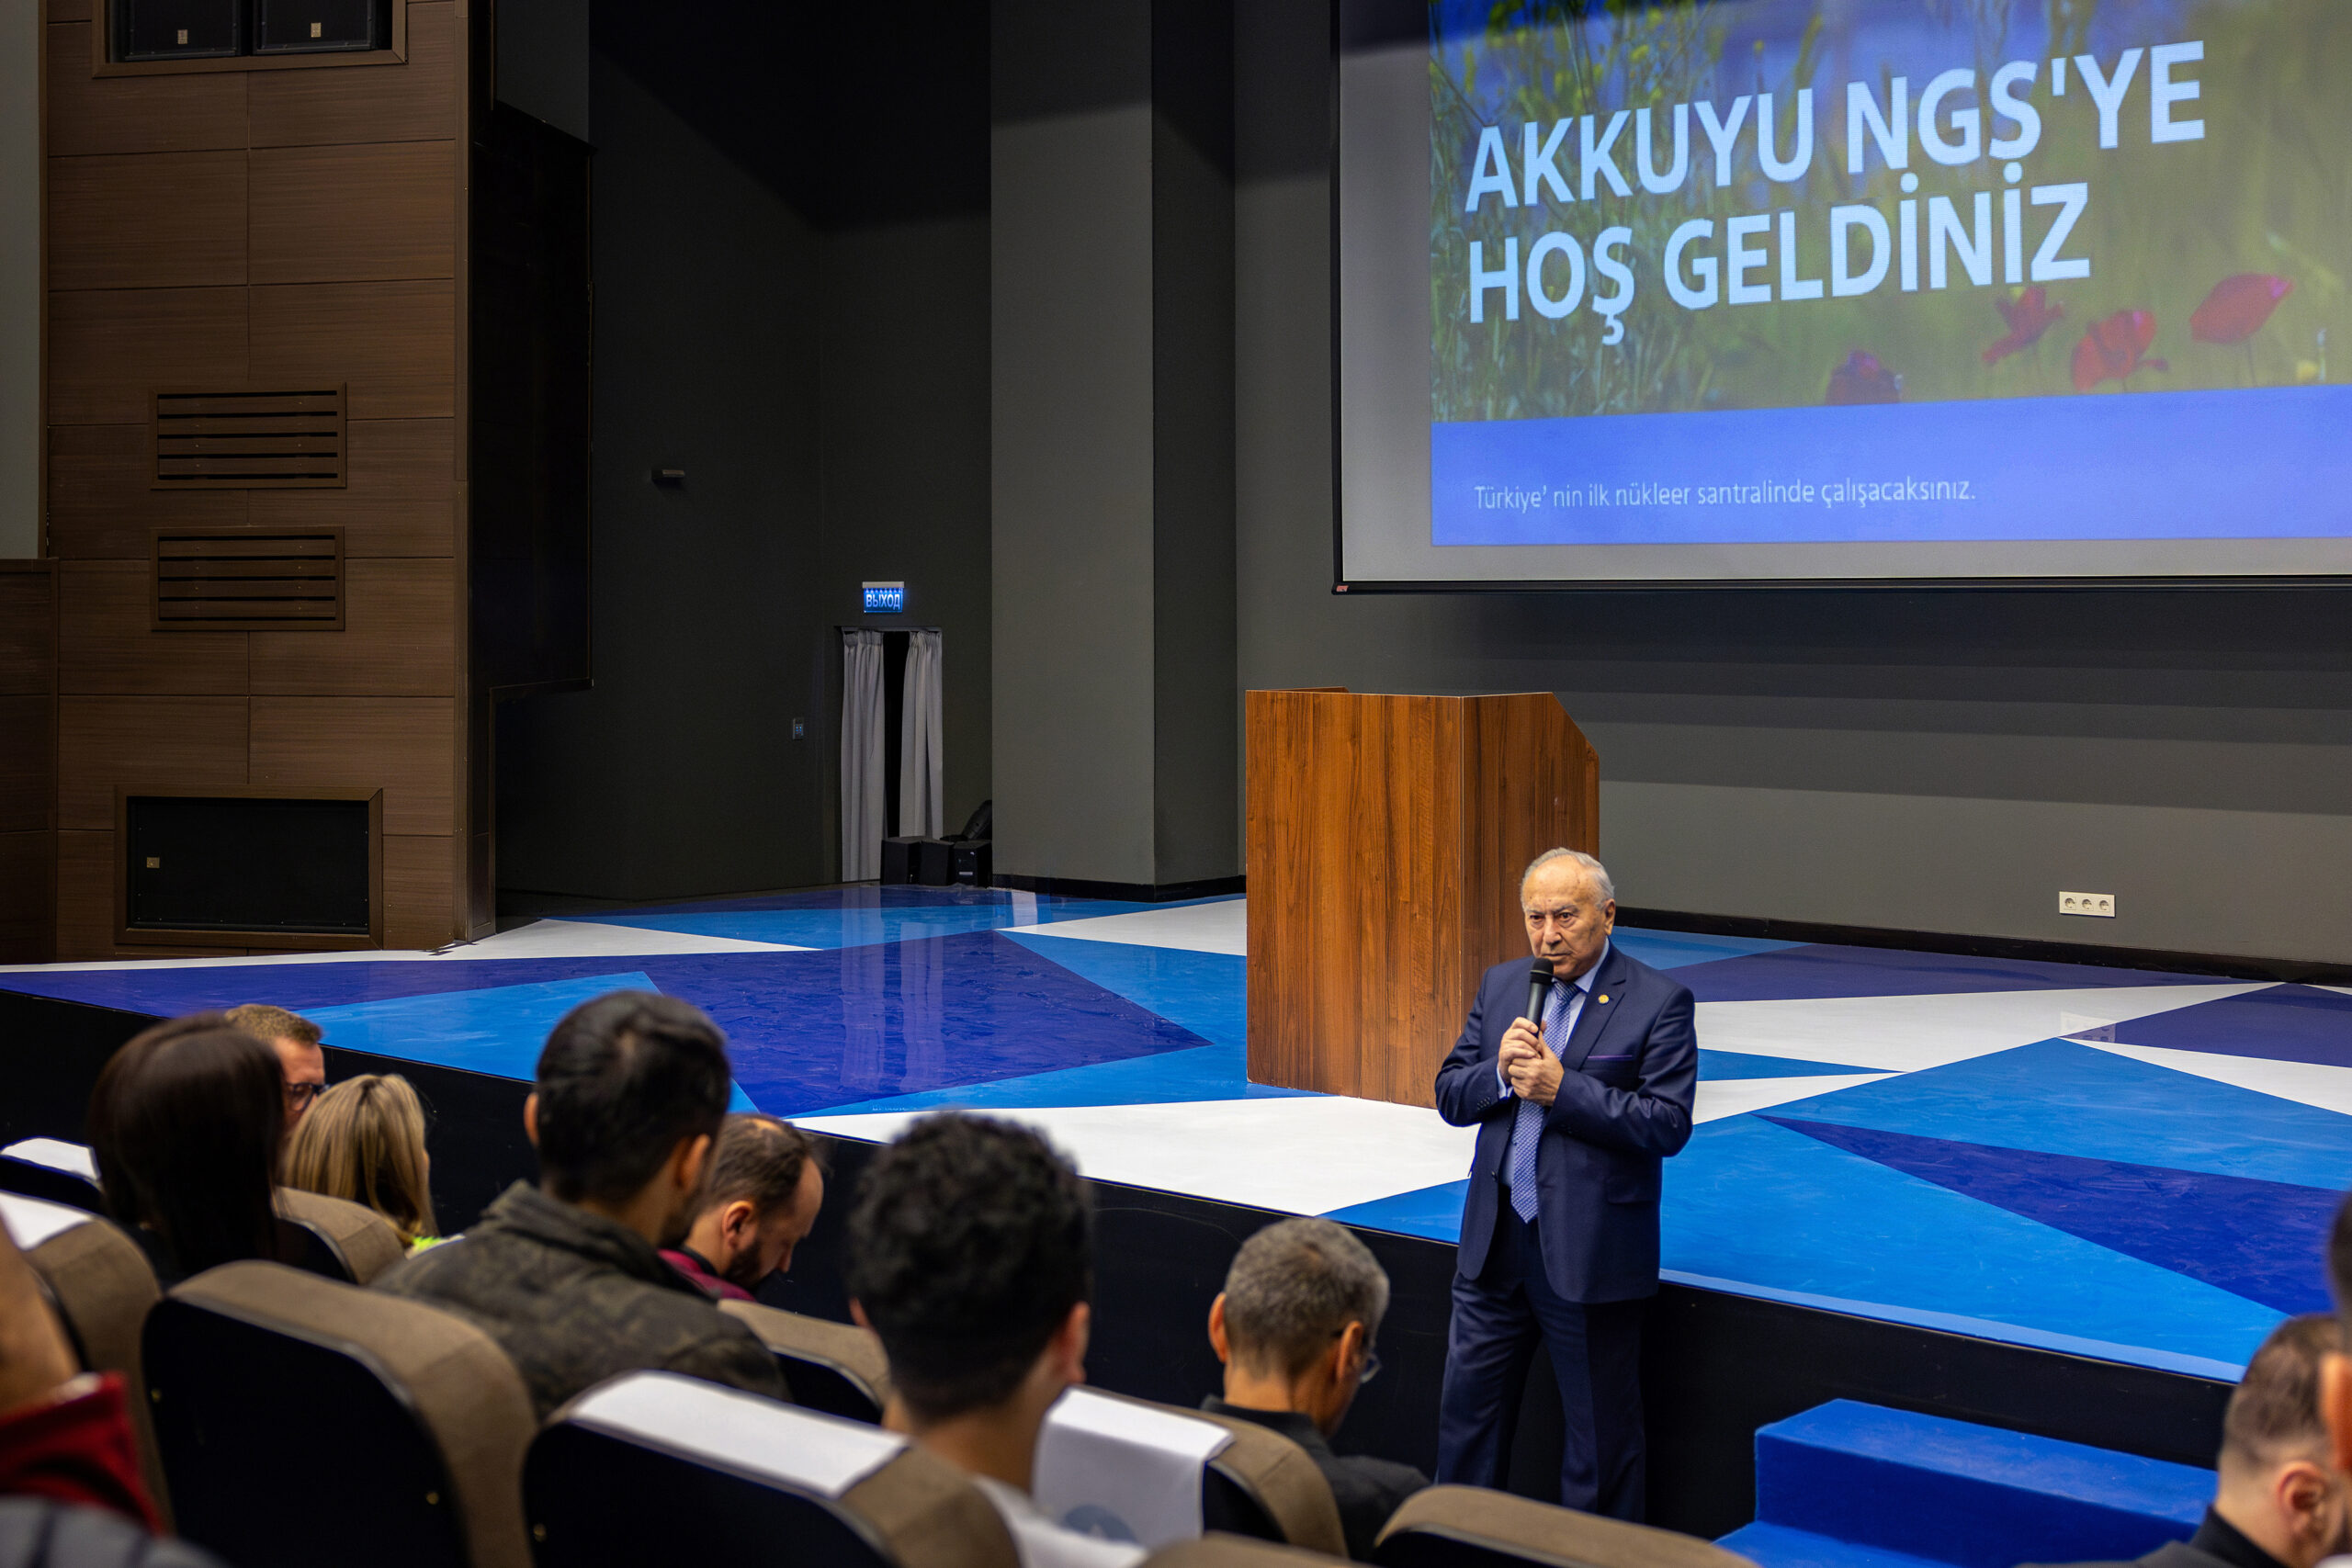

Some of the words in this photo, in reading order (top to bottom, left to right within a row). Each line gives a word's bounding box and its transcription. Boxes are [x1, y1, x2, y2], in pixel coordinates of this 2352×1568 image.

[1464, 88, 1814, 212] AKKUYU
[1847, 40, 2205, 175] NGS'YE
[1470, 226, 1635, 345] HOŞ
[1664, 162, 2090, 310] GELDİNİZ
[1553, 485, 1583, 507] nin
[1589, 484, 1610, 506] ilk
[1615, 482, 1690, 505] nükleer
[1698, 479, 1815, 504] santralinde
[1821, 476, 1976, 508] çalışacaksınız.
[865, 594, 900, 610] ВЫХОД
